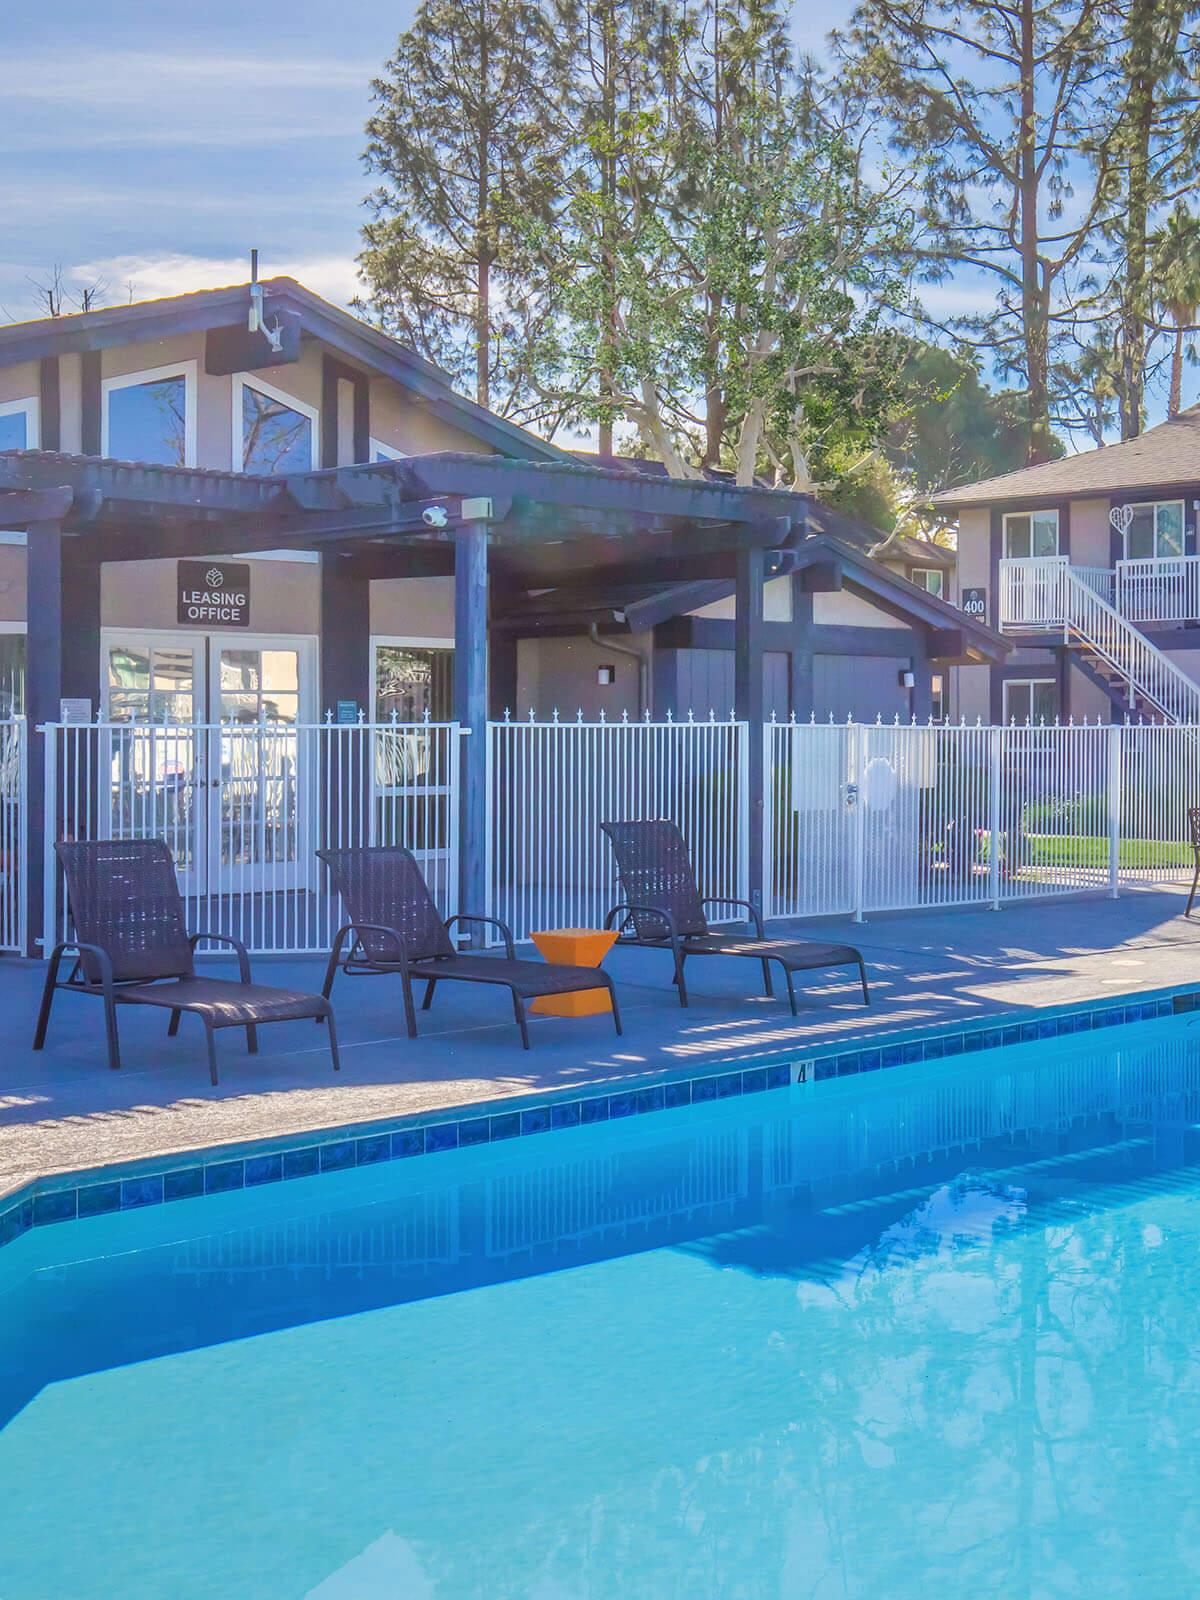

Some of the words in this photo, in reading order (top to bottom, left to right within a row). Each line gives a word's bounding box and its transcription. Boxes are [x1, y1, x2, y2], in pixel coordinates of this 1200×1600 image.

[182, 591, 246, 606] LEASING
[187, 606, 241, 621] OFFICE
[964, 600, 985, 613] 400
